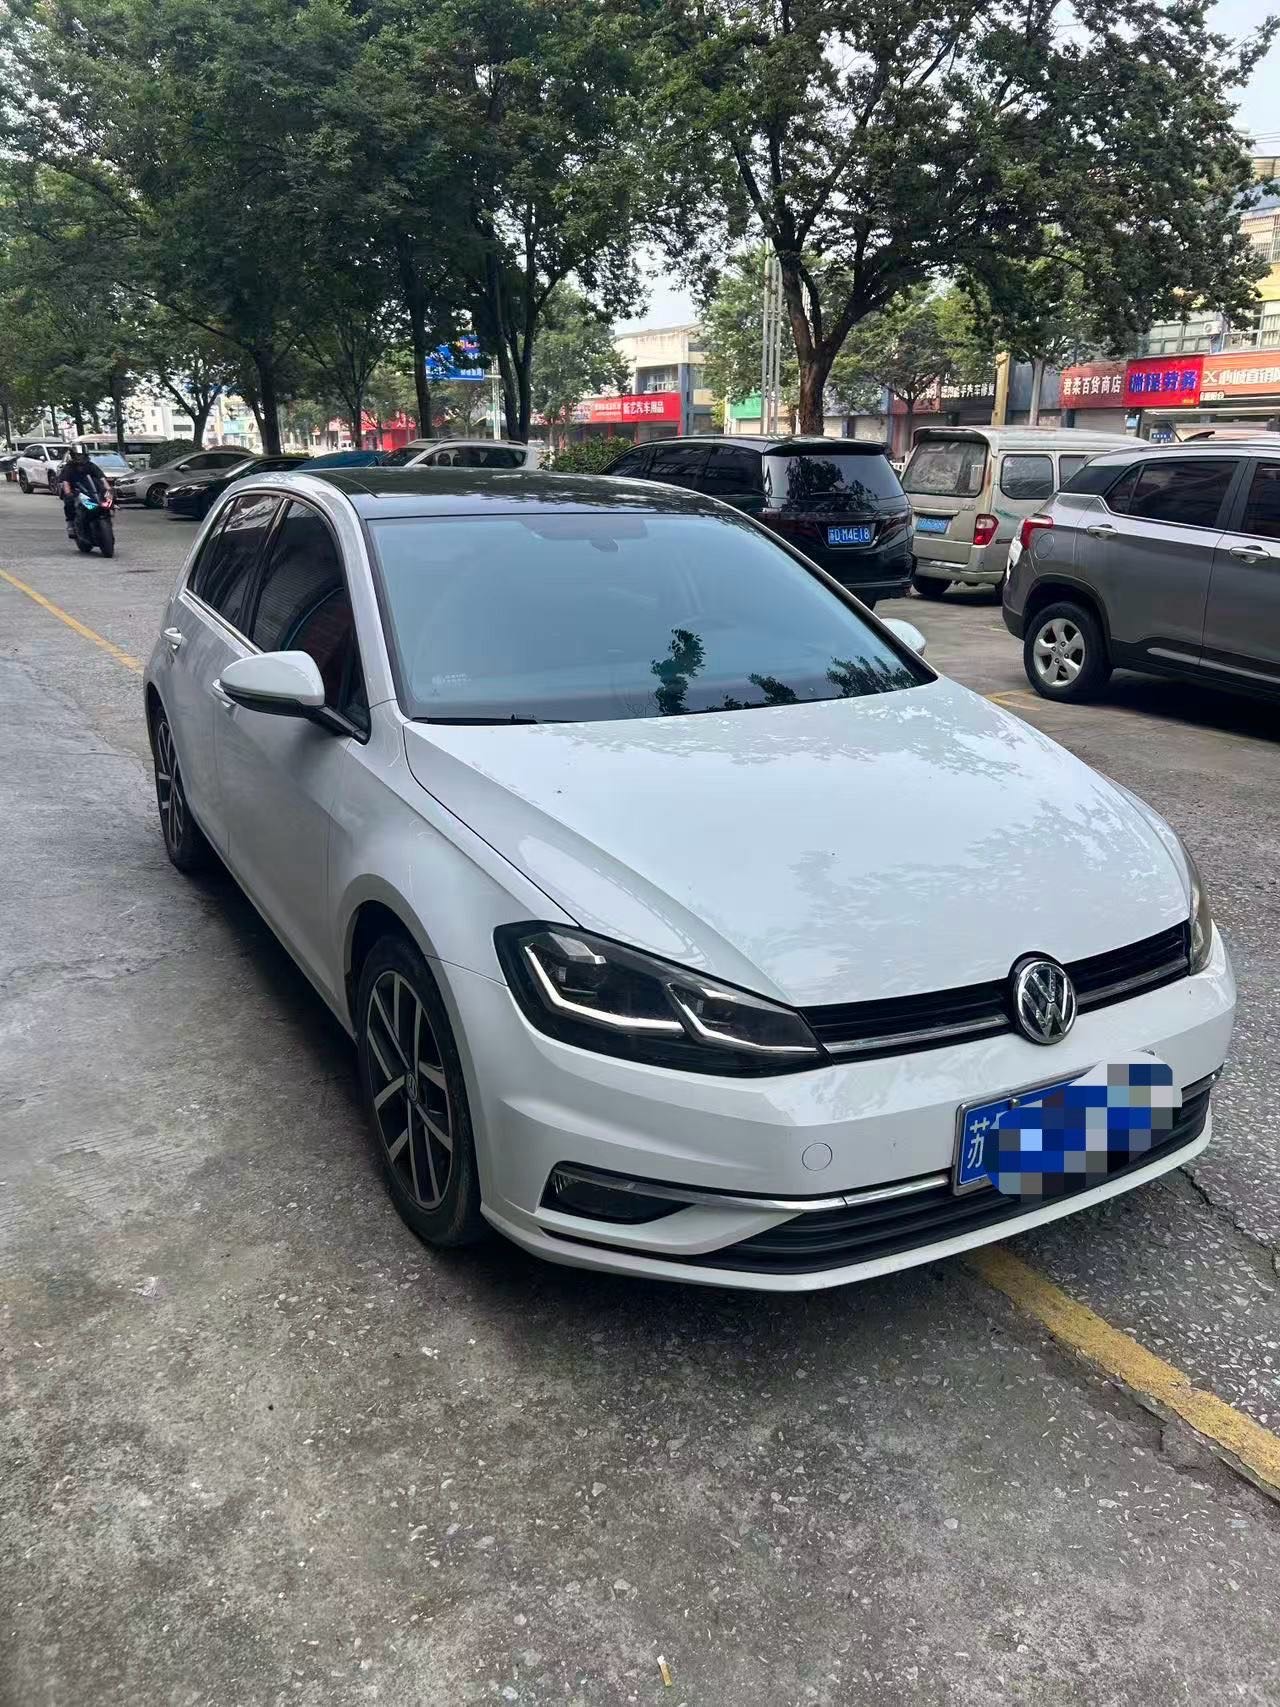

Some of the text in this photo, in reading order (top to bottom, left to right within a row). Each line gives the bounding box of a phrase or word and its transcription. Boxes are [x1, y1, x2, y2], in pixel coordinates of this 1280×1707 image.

[1063, 374, 1122, 396] 君柔百货商店
